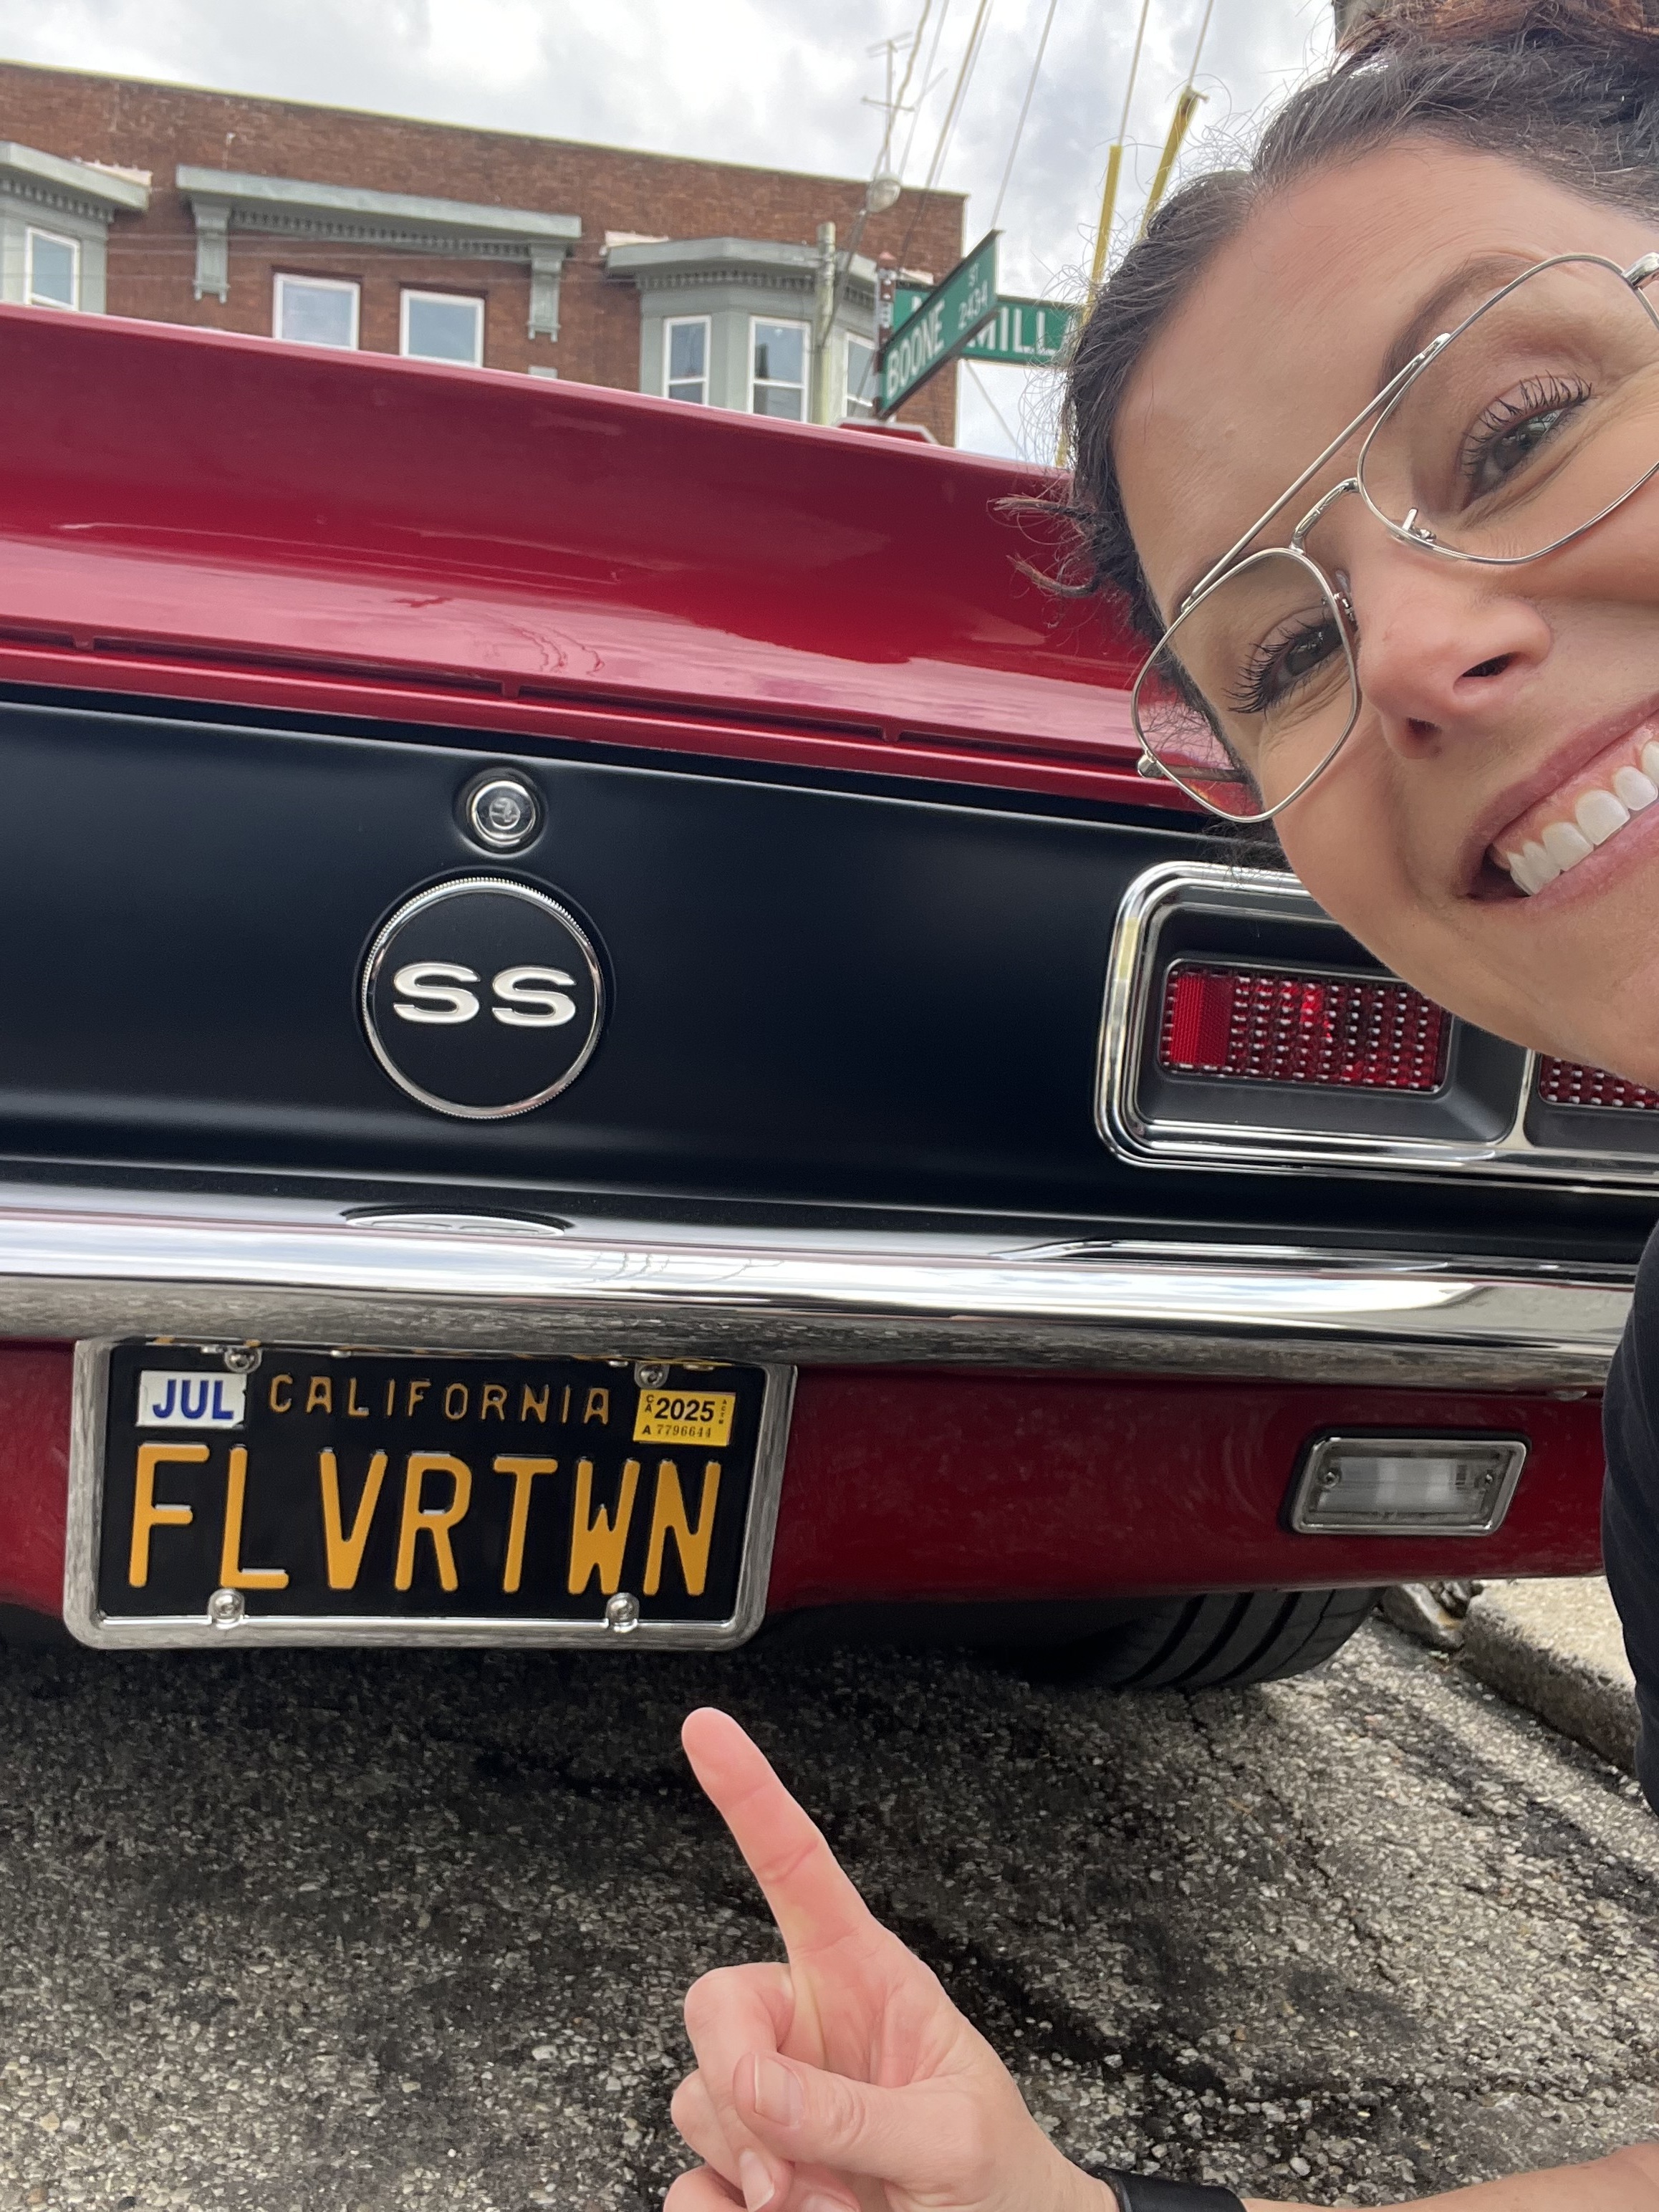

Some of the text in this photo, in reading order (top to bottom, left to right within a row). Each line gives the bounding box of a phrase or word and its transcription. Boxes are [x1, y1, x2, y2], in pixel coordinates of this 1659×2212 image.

[968, 262, 980, 287] ST
[886, 299, 946, 400] BOONE
[393, 961, 577, 1028] SS
[152, 1378, 235, 1420] JUL
[268, 1373, 610, 1425] CALIFORNIA
[655, 1398, 715, 1422] 2025
[642, 1425, 651, 1436] A
